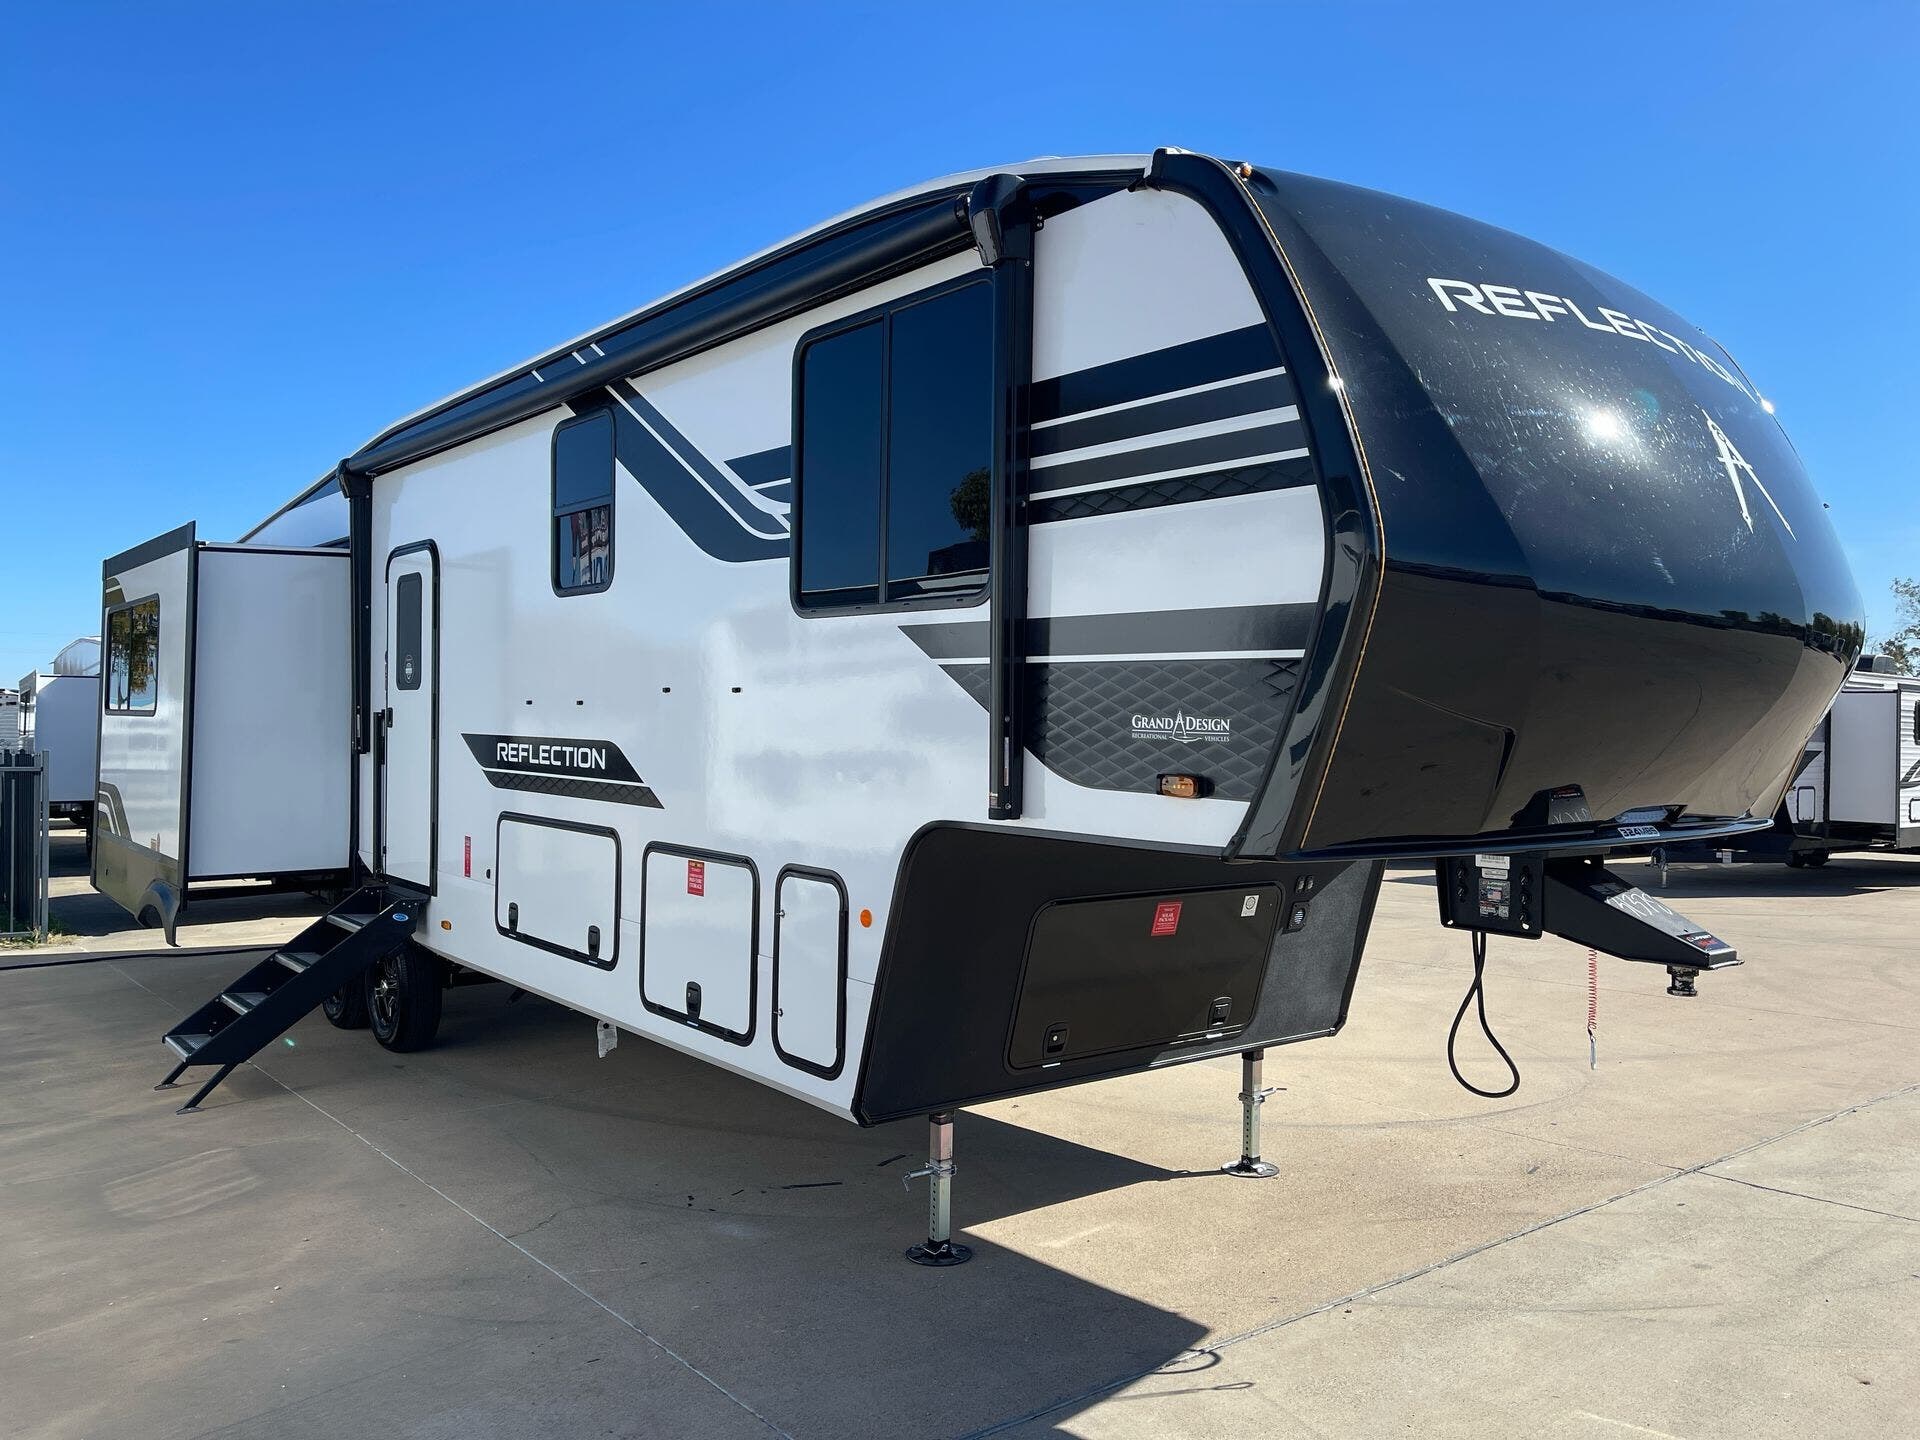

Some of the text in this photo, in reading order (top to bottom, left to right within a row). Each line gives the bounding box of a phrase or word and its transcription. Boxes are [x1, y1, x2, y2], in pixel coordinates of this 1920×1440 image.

[1427, 277, 1758, 404] REFLECTION
[1131, 714, 1231, 732] GRAND DESIGN
[1131, 733, 1230, 743] RECREATIONAL VEHICLES
[496, 742, 606, 770] REFLECTION
